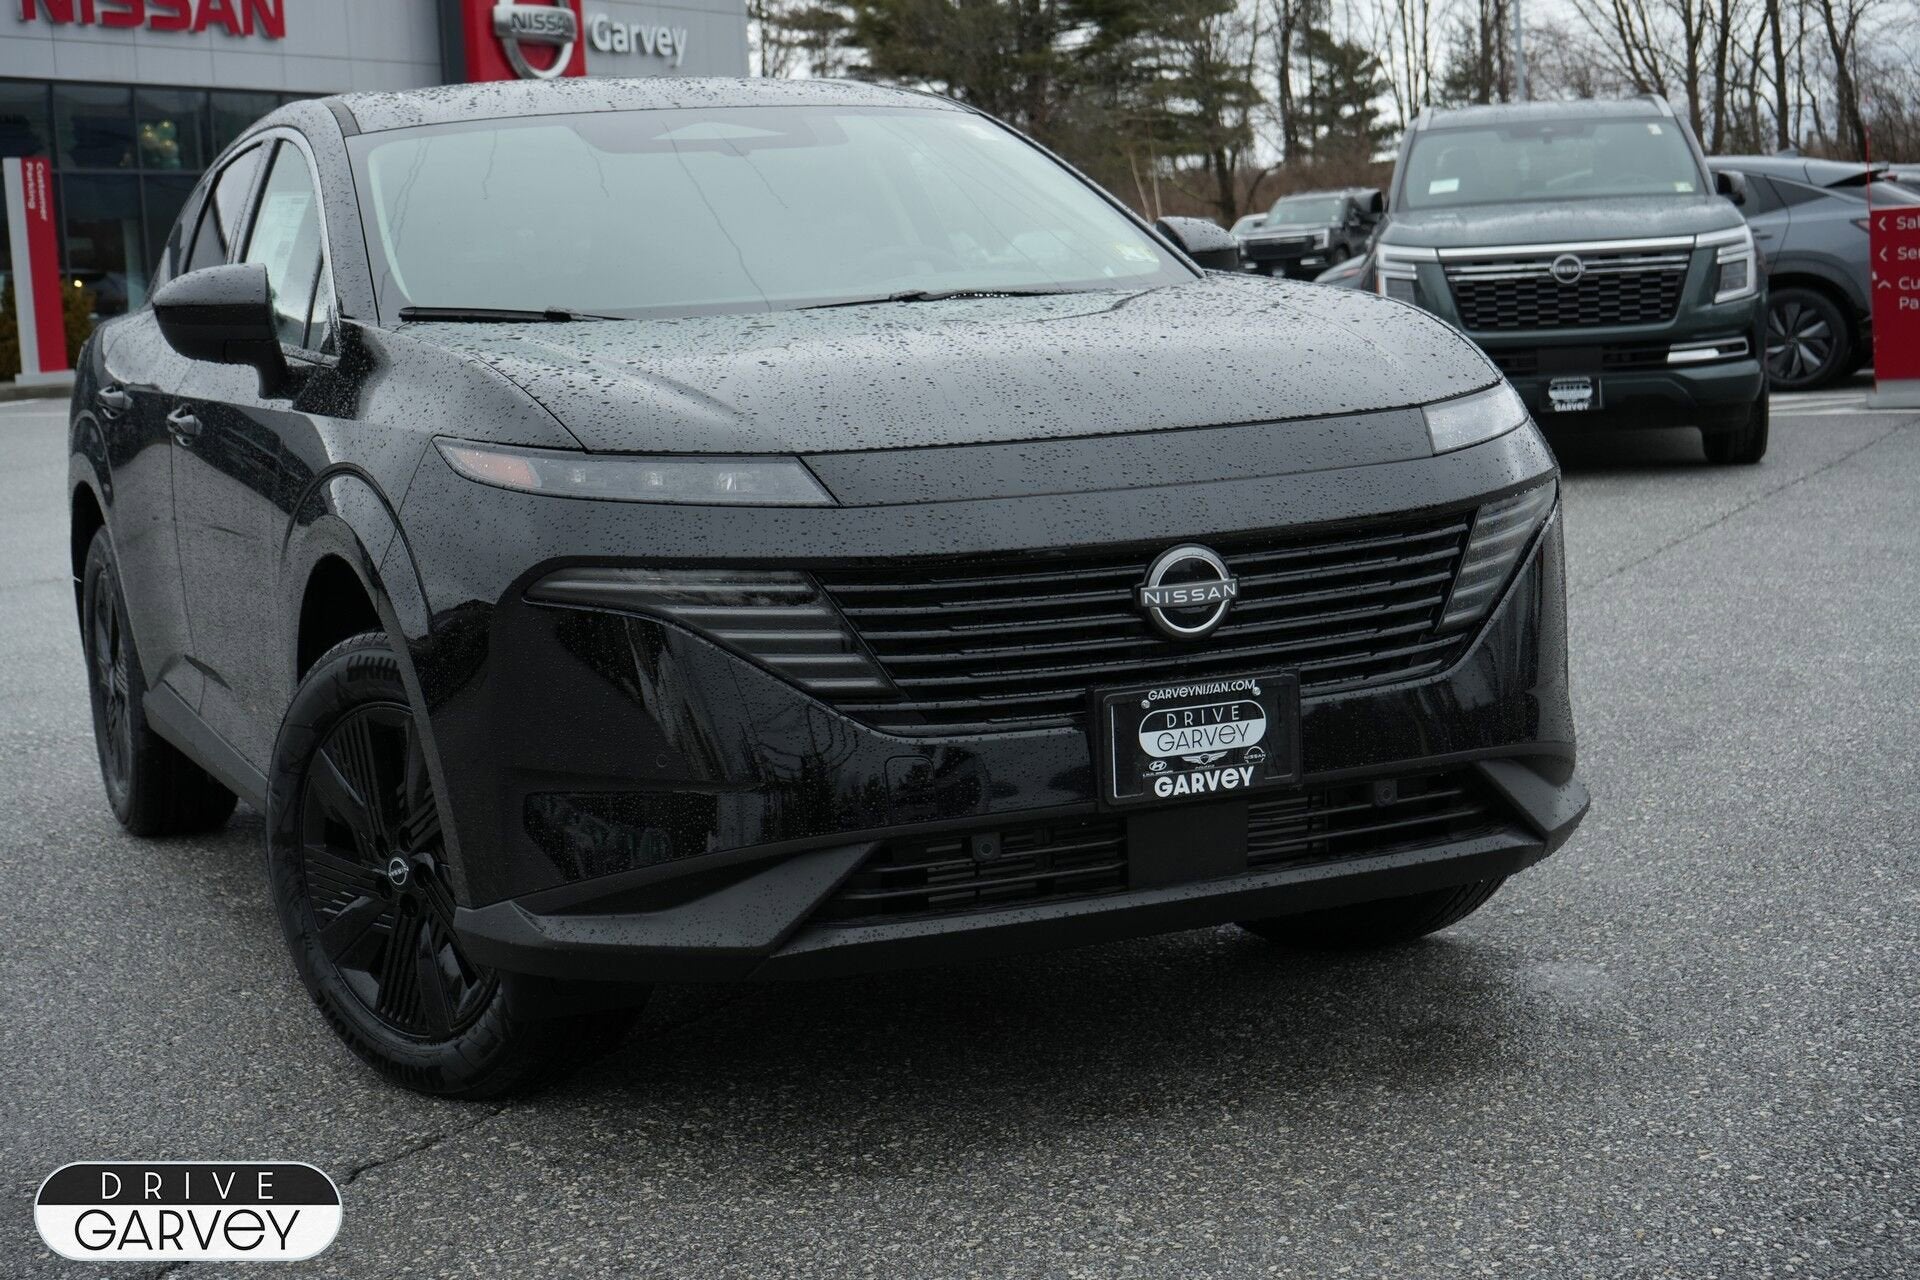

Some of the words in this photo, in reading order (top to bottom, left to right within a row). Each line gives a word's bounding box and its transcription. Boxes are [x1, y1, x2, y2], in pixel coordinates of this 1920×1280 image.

[591, 13, 688, 67] Garvey
[1144, 582, 1236, 604] NISSAN
[1148, 679, 1256, 701] GARVEYNISSAN.COM
[1166, 705, 1240, 729] DRIVE
[1156, 722, 1250, 752] GARVEY
[1154, 765, 1255, 798] GARVEY
